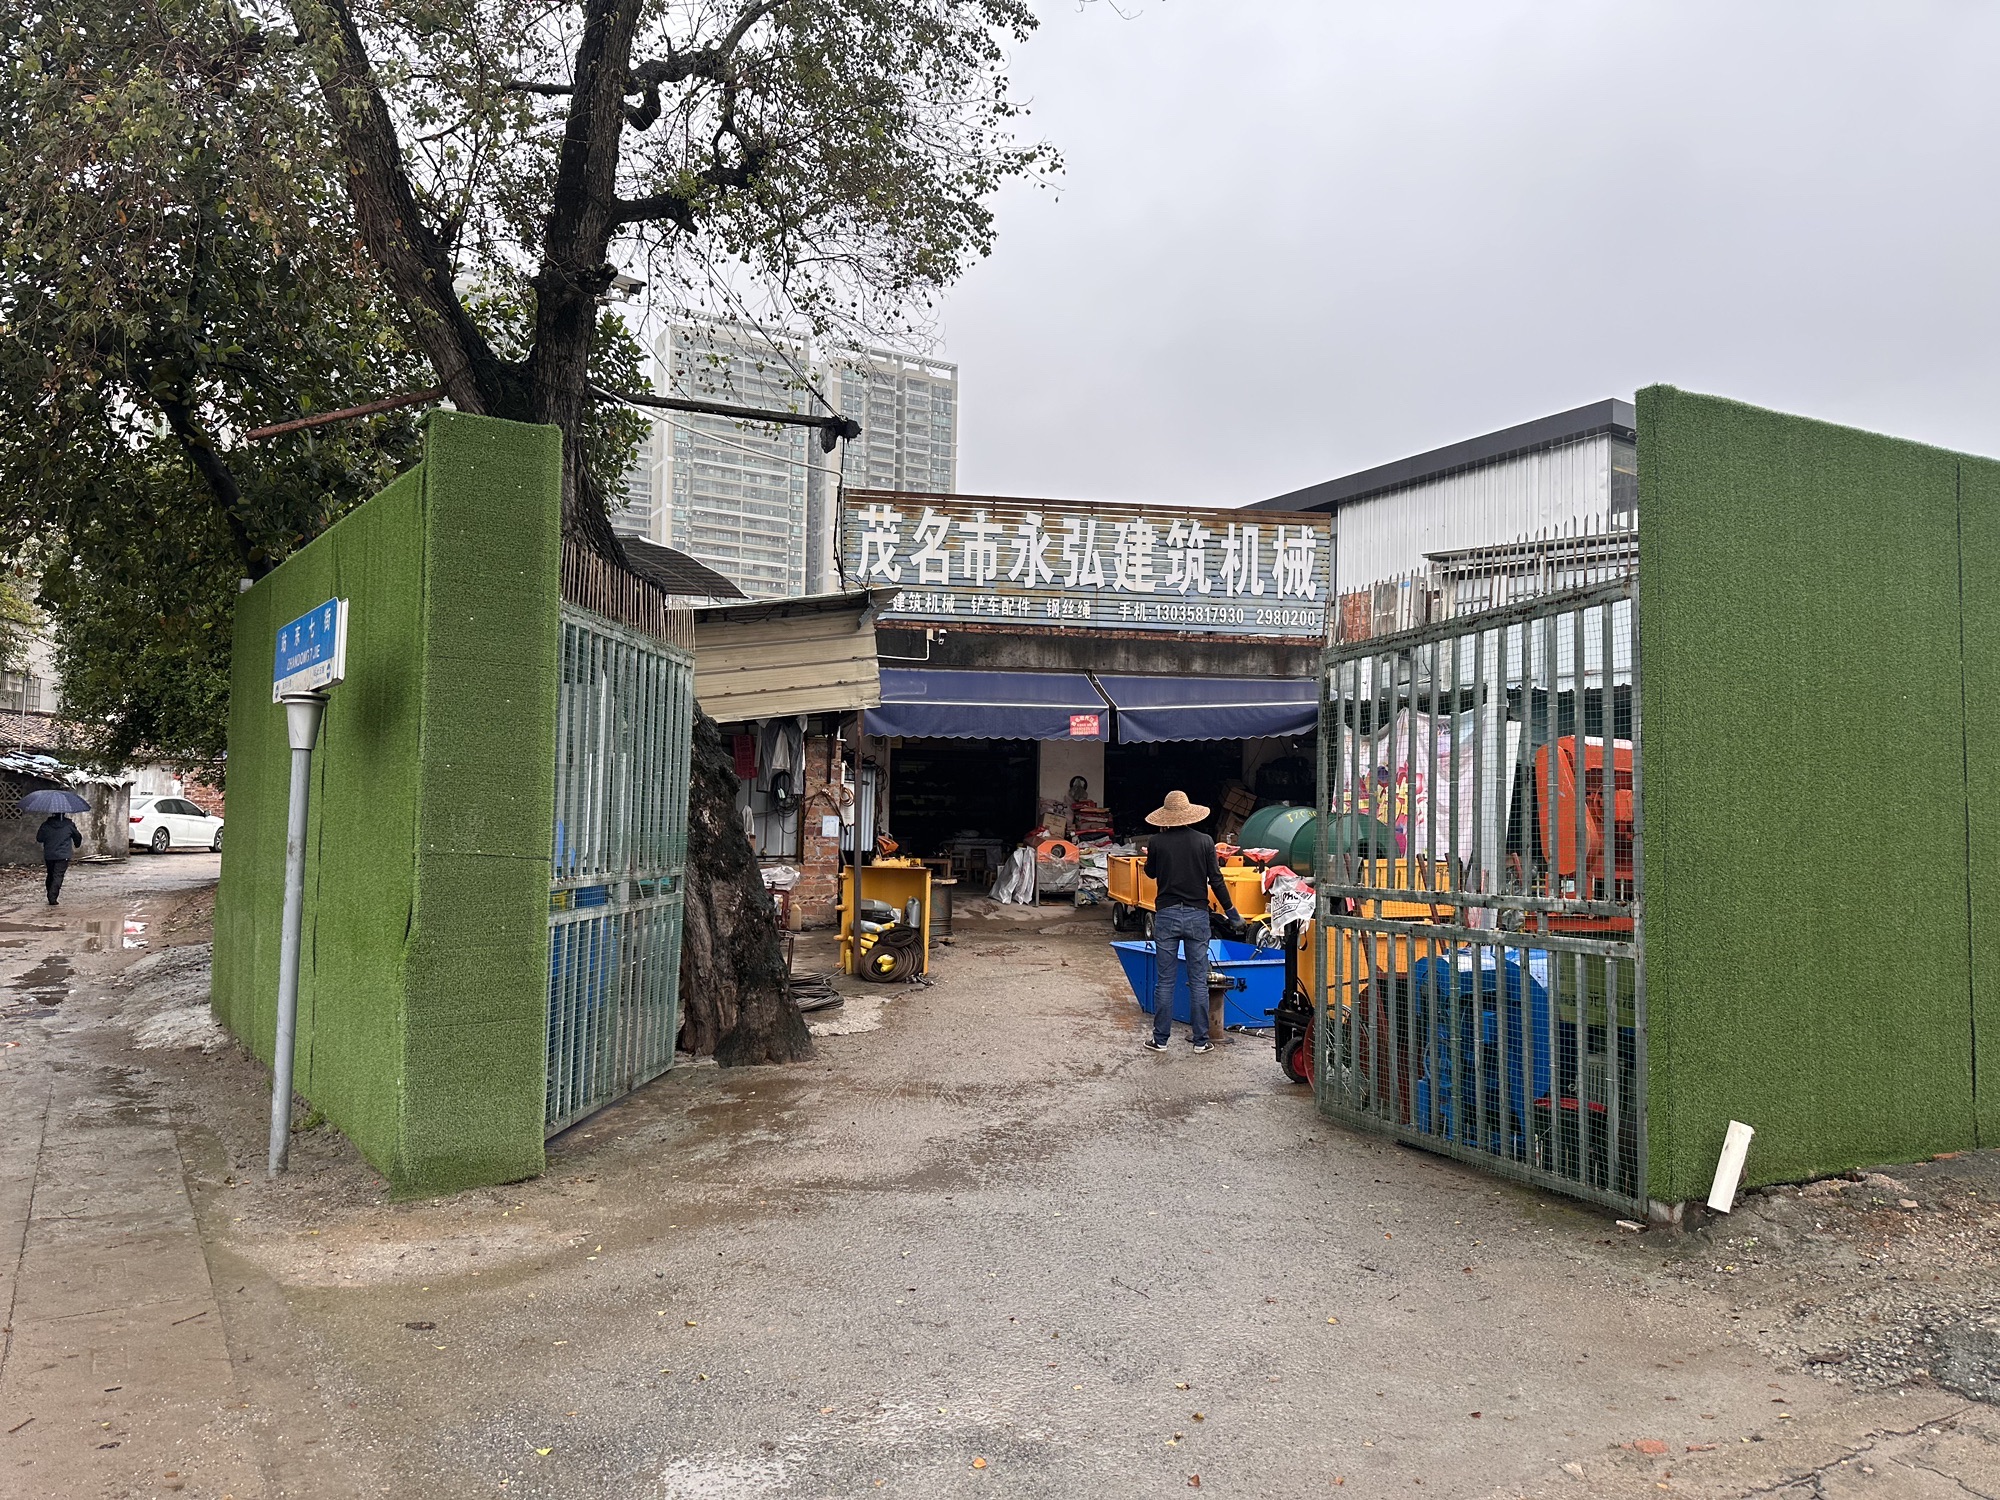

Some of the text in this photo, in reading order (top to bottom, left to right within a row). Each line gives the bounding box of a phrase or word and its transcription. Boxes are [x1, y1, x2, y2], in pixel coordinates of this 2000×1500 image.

[856, 504, 1317, 601] 茂名市永弘建筑机械
[281, 608, 331, 653] 站东七街
[892, 592, 956, 615] 建筑机械
[971, 595, 1031, 617] 铲车配件
[1046, 598, 1091, 620] 钢丝绳
[1256, 608, 1317, 627] 2980200
